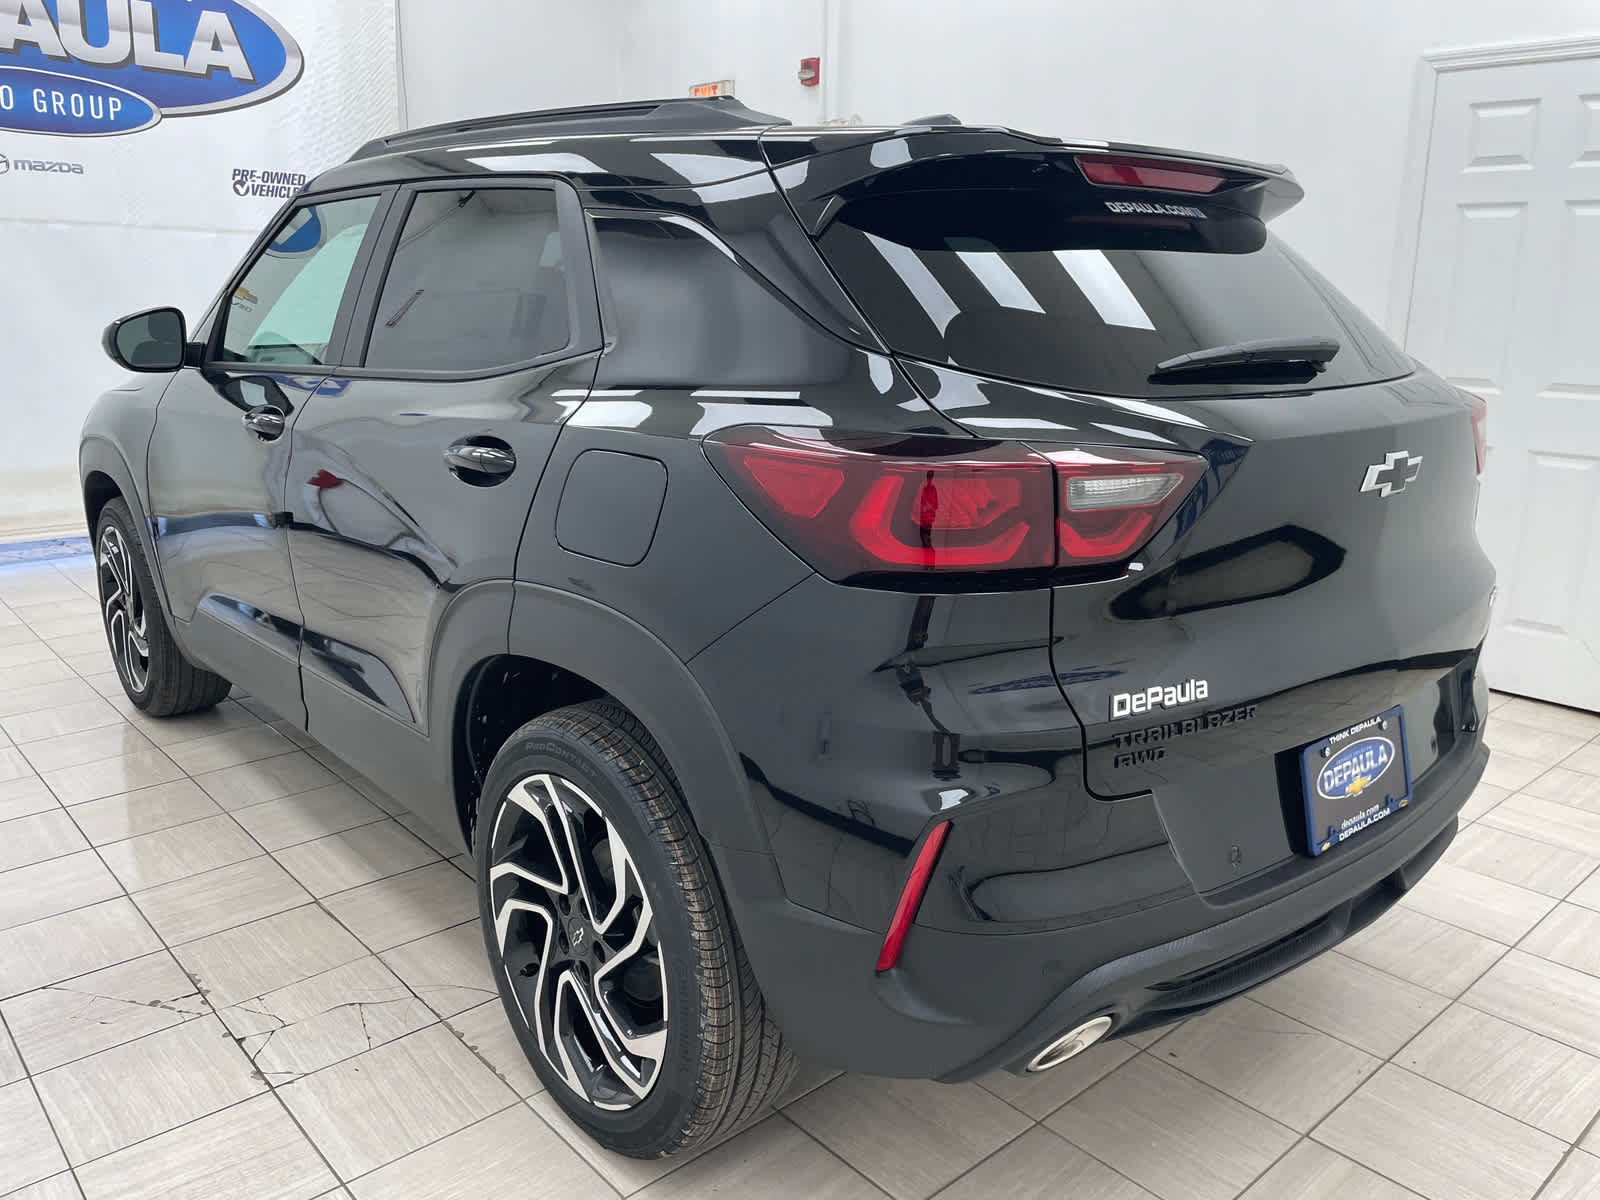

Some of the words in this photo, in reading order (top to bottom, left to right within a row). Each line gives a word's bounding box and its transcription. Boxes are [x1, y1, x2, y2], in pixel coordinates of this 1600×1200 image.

[33, 88, 122, 121] GROUP
[694, 85, 718, 97] EXIT
[13, 159, 84, 175] mazda
[232, 168, 306, 186] PRE-OWNED
[251, 183, 300, 199] VEHICL
[1113, 679, 1208, 717] DePaula
[1112, 704, 1257, 749] TRAILBLAZER
[1329, 728, 1350, 745] THINK
[1350, 716, 1382, 735] DEPAULA
[1323, 744, 1388, 793] DEPAULA
[1339, 808, 1391, 841] DEPAULA.COM
[1341, 804, 1380, 829] depaula.com
